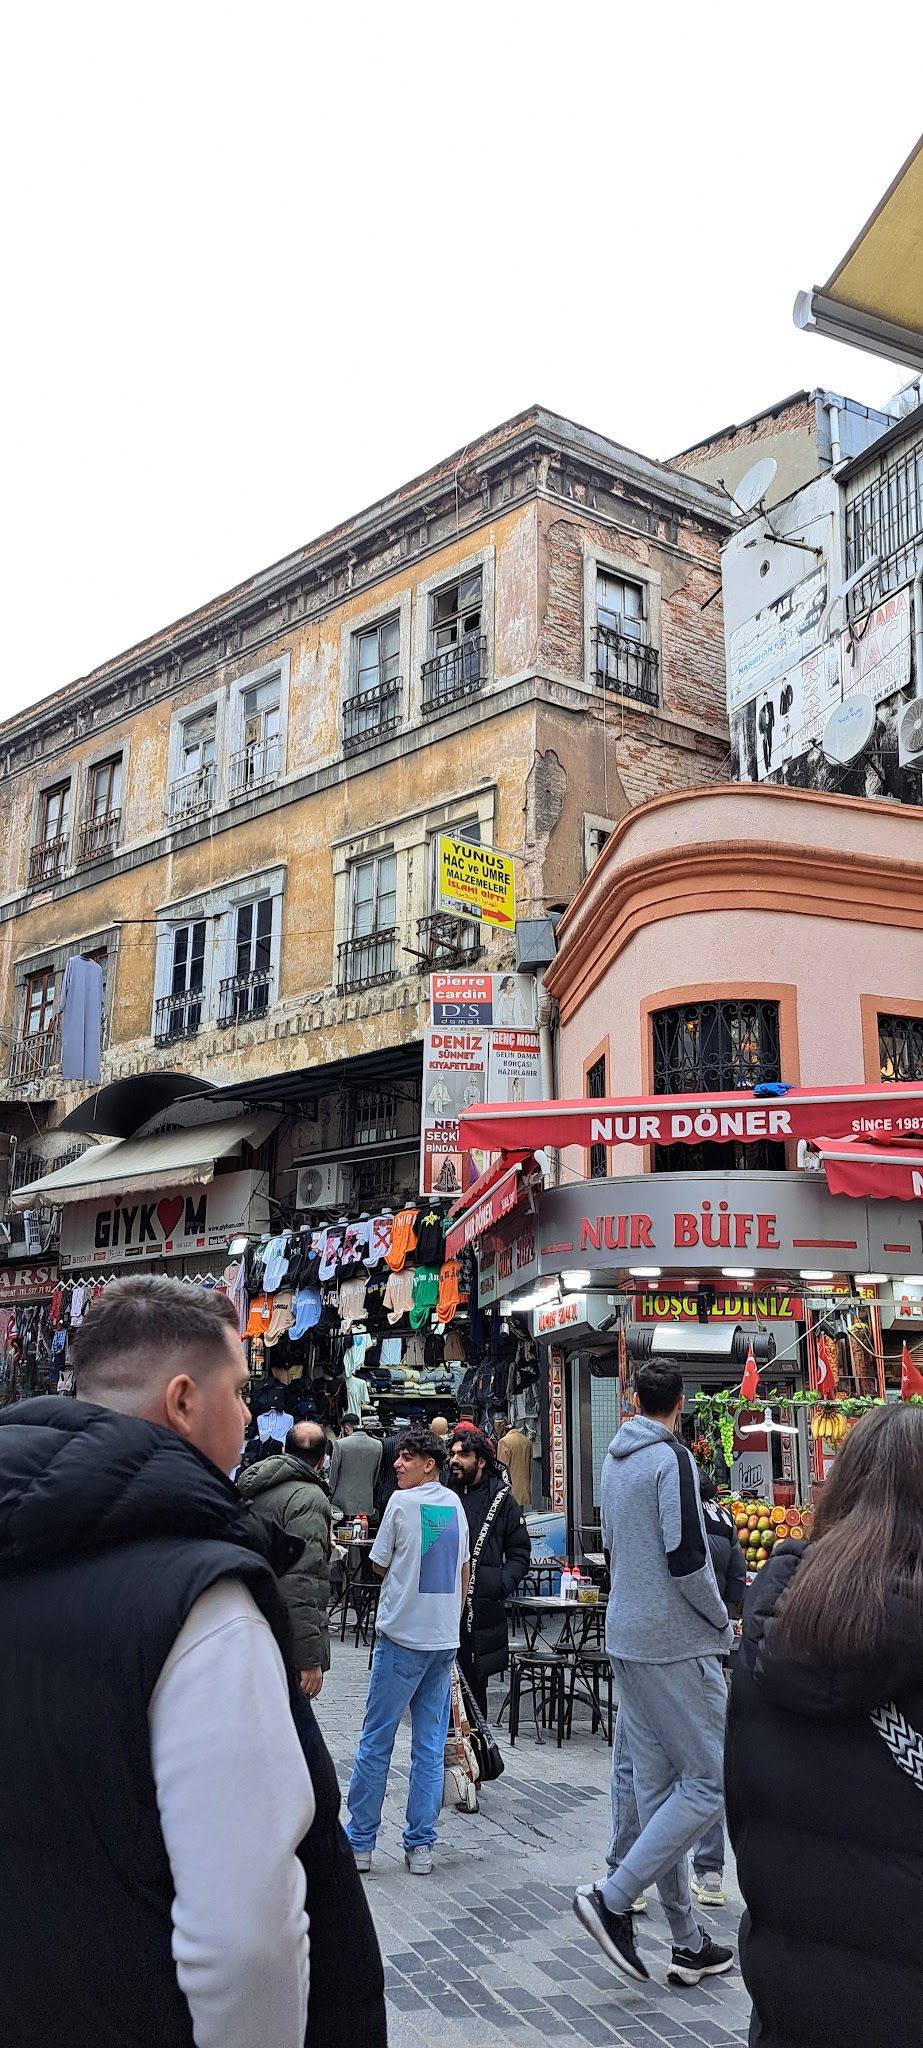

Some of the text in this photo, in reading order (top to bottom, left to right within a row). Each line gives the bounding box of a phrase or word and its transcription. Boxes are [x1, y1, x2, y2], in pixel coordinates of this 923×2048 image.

[451, 843, 504, 870] YUNUS
[443, 852, 511, 886] HAC ve UMRE
[446, 868, 507, 896] MALZEMELERİ
[436, 977, 486, 987] pierre
[435, 989, 487, 999] cardin
[431, 1033, 482, 1051] DENİZ
[493, 1031, 516, 1048] GENÇ
[438, 1050, 475, 1060] SÜNNET
[429, 1061, 484, 1071] KIYAFETLERİ
[497, 1069, 538, 1077] HAZIRLANIR
[591, 1108, 793, 1141] NUR DÖNER
[426, 1143, 468, 1153] BİNDAL
[579, 1200, 780, 1250] NUR BÜFE
[466, 1490, 505, 1634] MONCLER MONCLER MONCLER MONCLER
